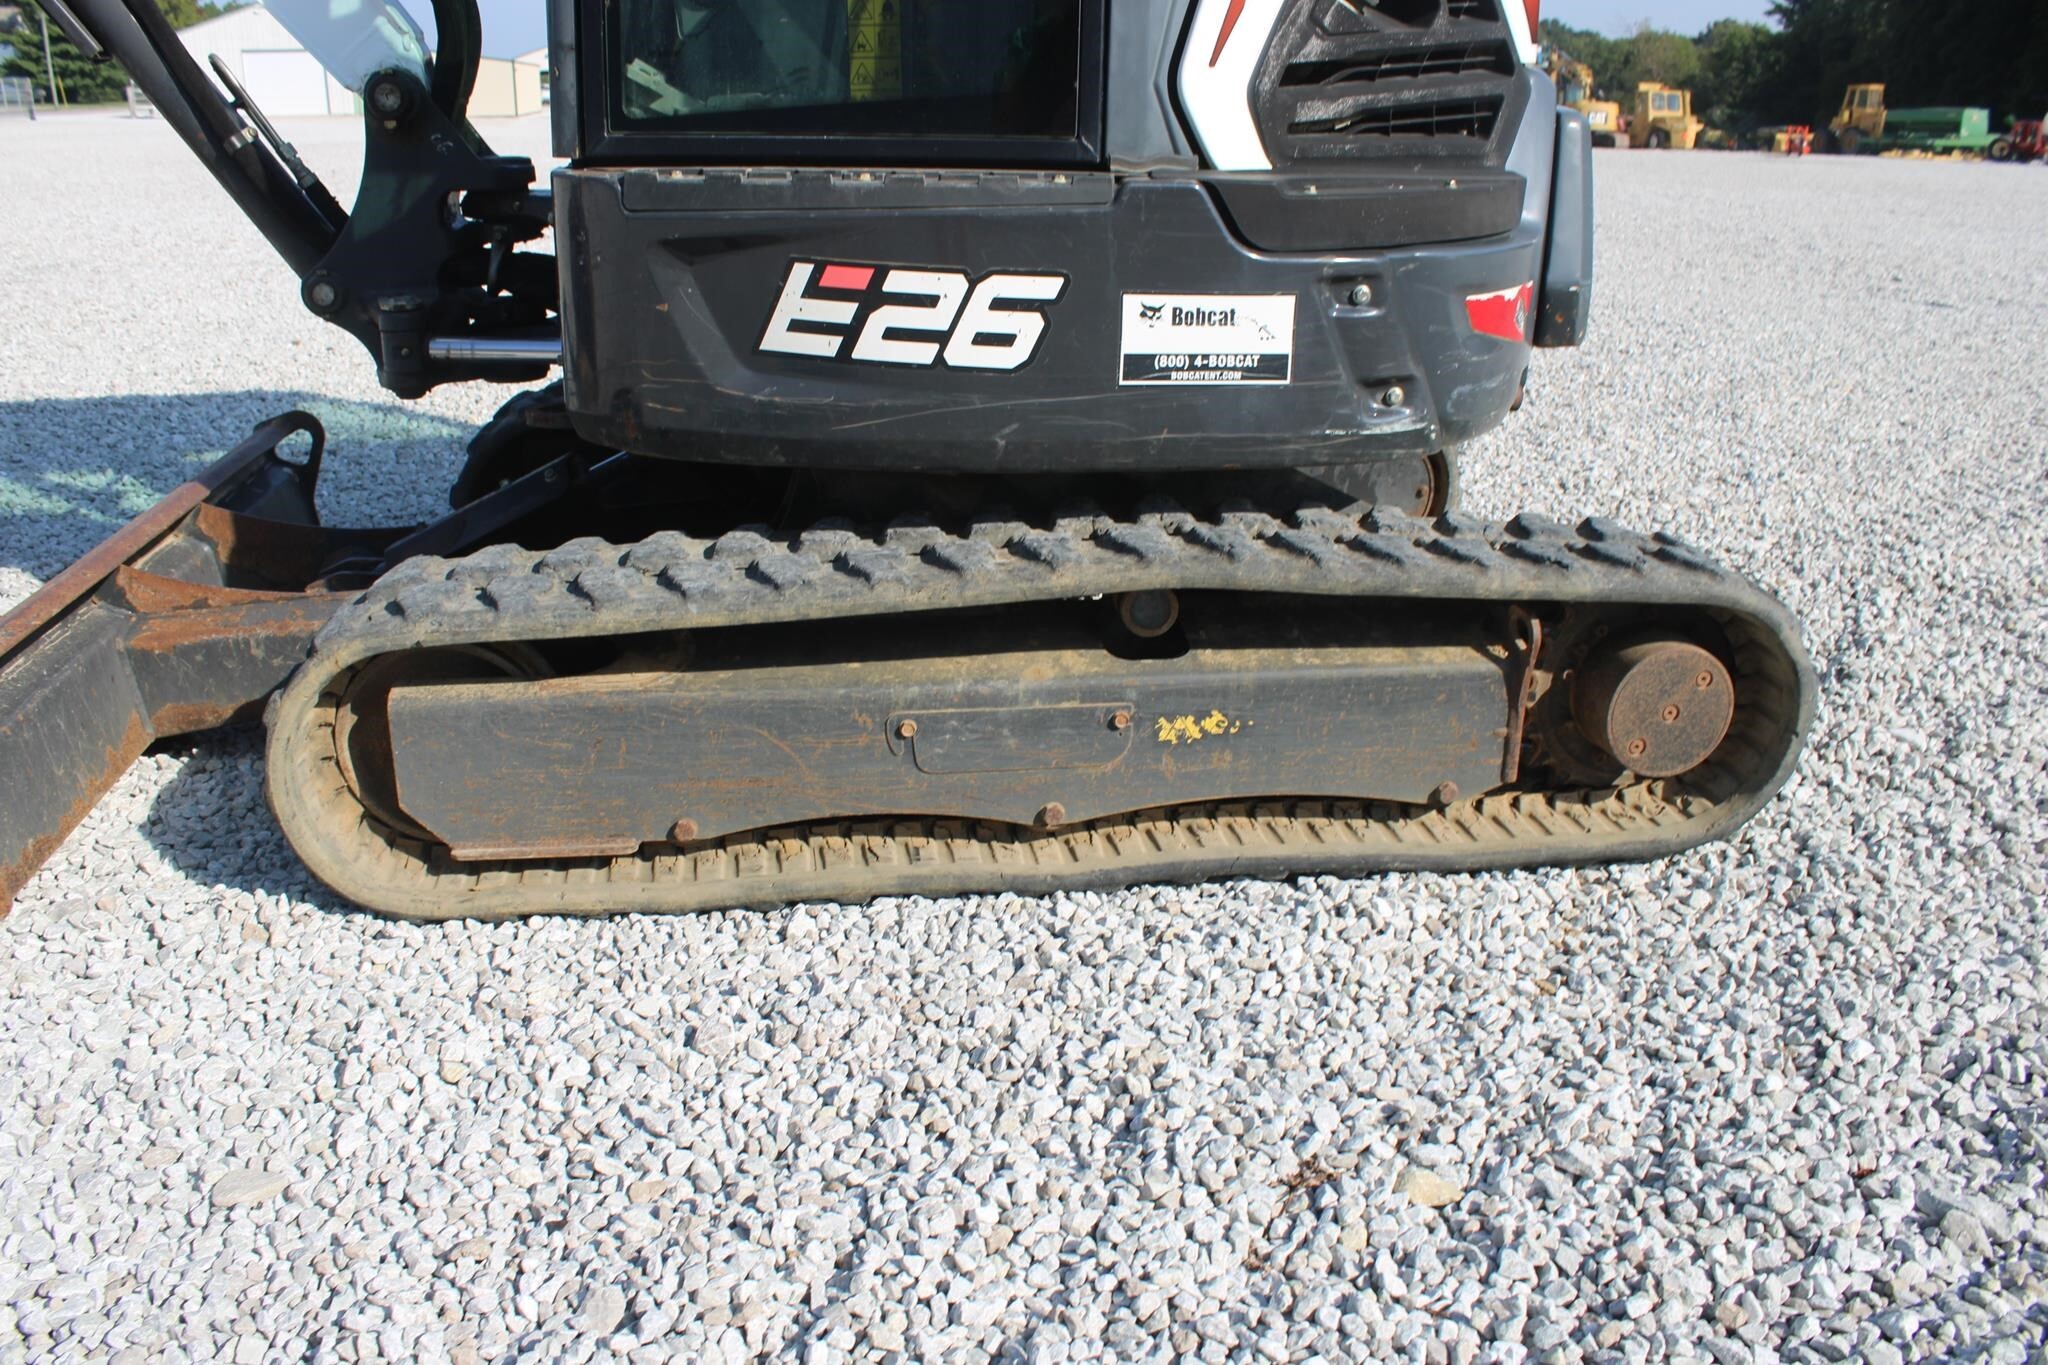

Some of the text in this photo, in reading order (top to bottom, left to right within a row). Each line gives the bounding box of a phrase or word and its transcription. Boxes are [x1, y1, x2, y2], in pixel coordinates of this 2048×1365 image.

[759, 261, 1065, 370] E26
[1171, 306, 1236, 327] Bobcat
[1154, 354, 1261, 370] (800) 4-BOBCAT
[1170, 370, 1242, 381] BOBCATENT.COM
